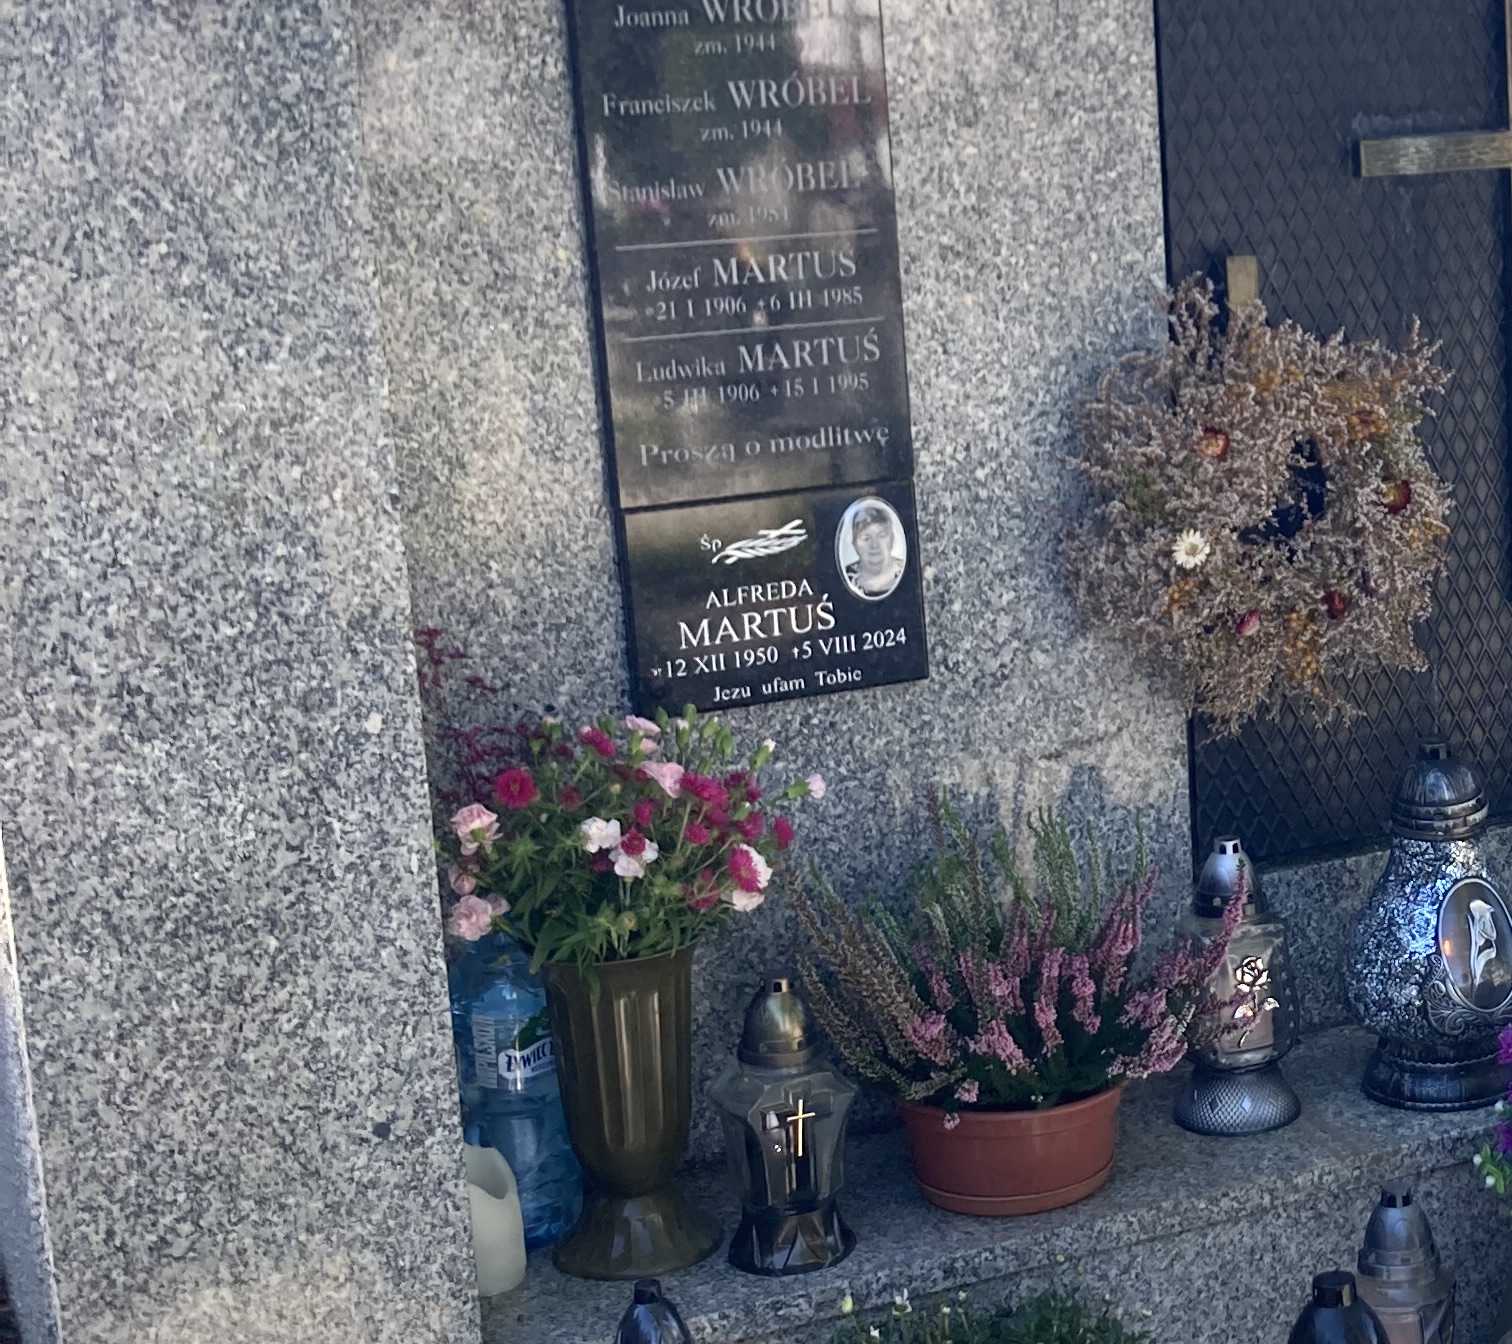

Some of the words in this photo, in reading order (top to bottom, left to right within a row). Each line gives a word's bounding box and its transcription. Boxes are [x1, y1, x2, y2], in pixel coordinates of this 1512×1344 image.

[614, 4, 690, 29] Joanna
[602, 90, 716, 118] Franciszek
[727, 71, 872, 111] WRÓBEL
[742, 118, 783, 139] 1944
[717, 157, 862, 196] WRÓBEL
[646, 266, 702, 293] Józef
[705, 296, 747, 317] 1906
[822, 286, 863, 308] 1985
[636, 356, 726, 383] Ludwika
[738, 327, 881, 374] MARTUŚ
[719, 383, 760, 405] 1906
[829, 372, 870, 394] 1995
[745, 440, 761, 456] o
[770, 426, 889, 453] modlitwę
[706, 578, 814, 609] ALFREDA
[677, 594, 836, 650] MARTUŚ
[666, 659, 688, 678] 12
[693, 653, 726, 674] XII
[734, 645, 779, 668] 1950
[802, 641, 813, 660] 5
[819, 634, 857, 656] VIII
[862, 628, 908, 651] 2024
[713, 685, 752, 703] Jezu
[762, 677, 806, 695] ufam
[815, 667, 863, 687] Tobie
